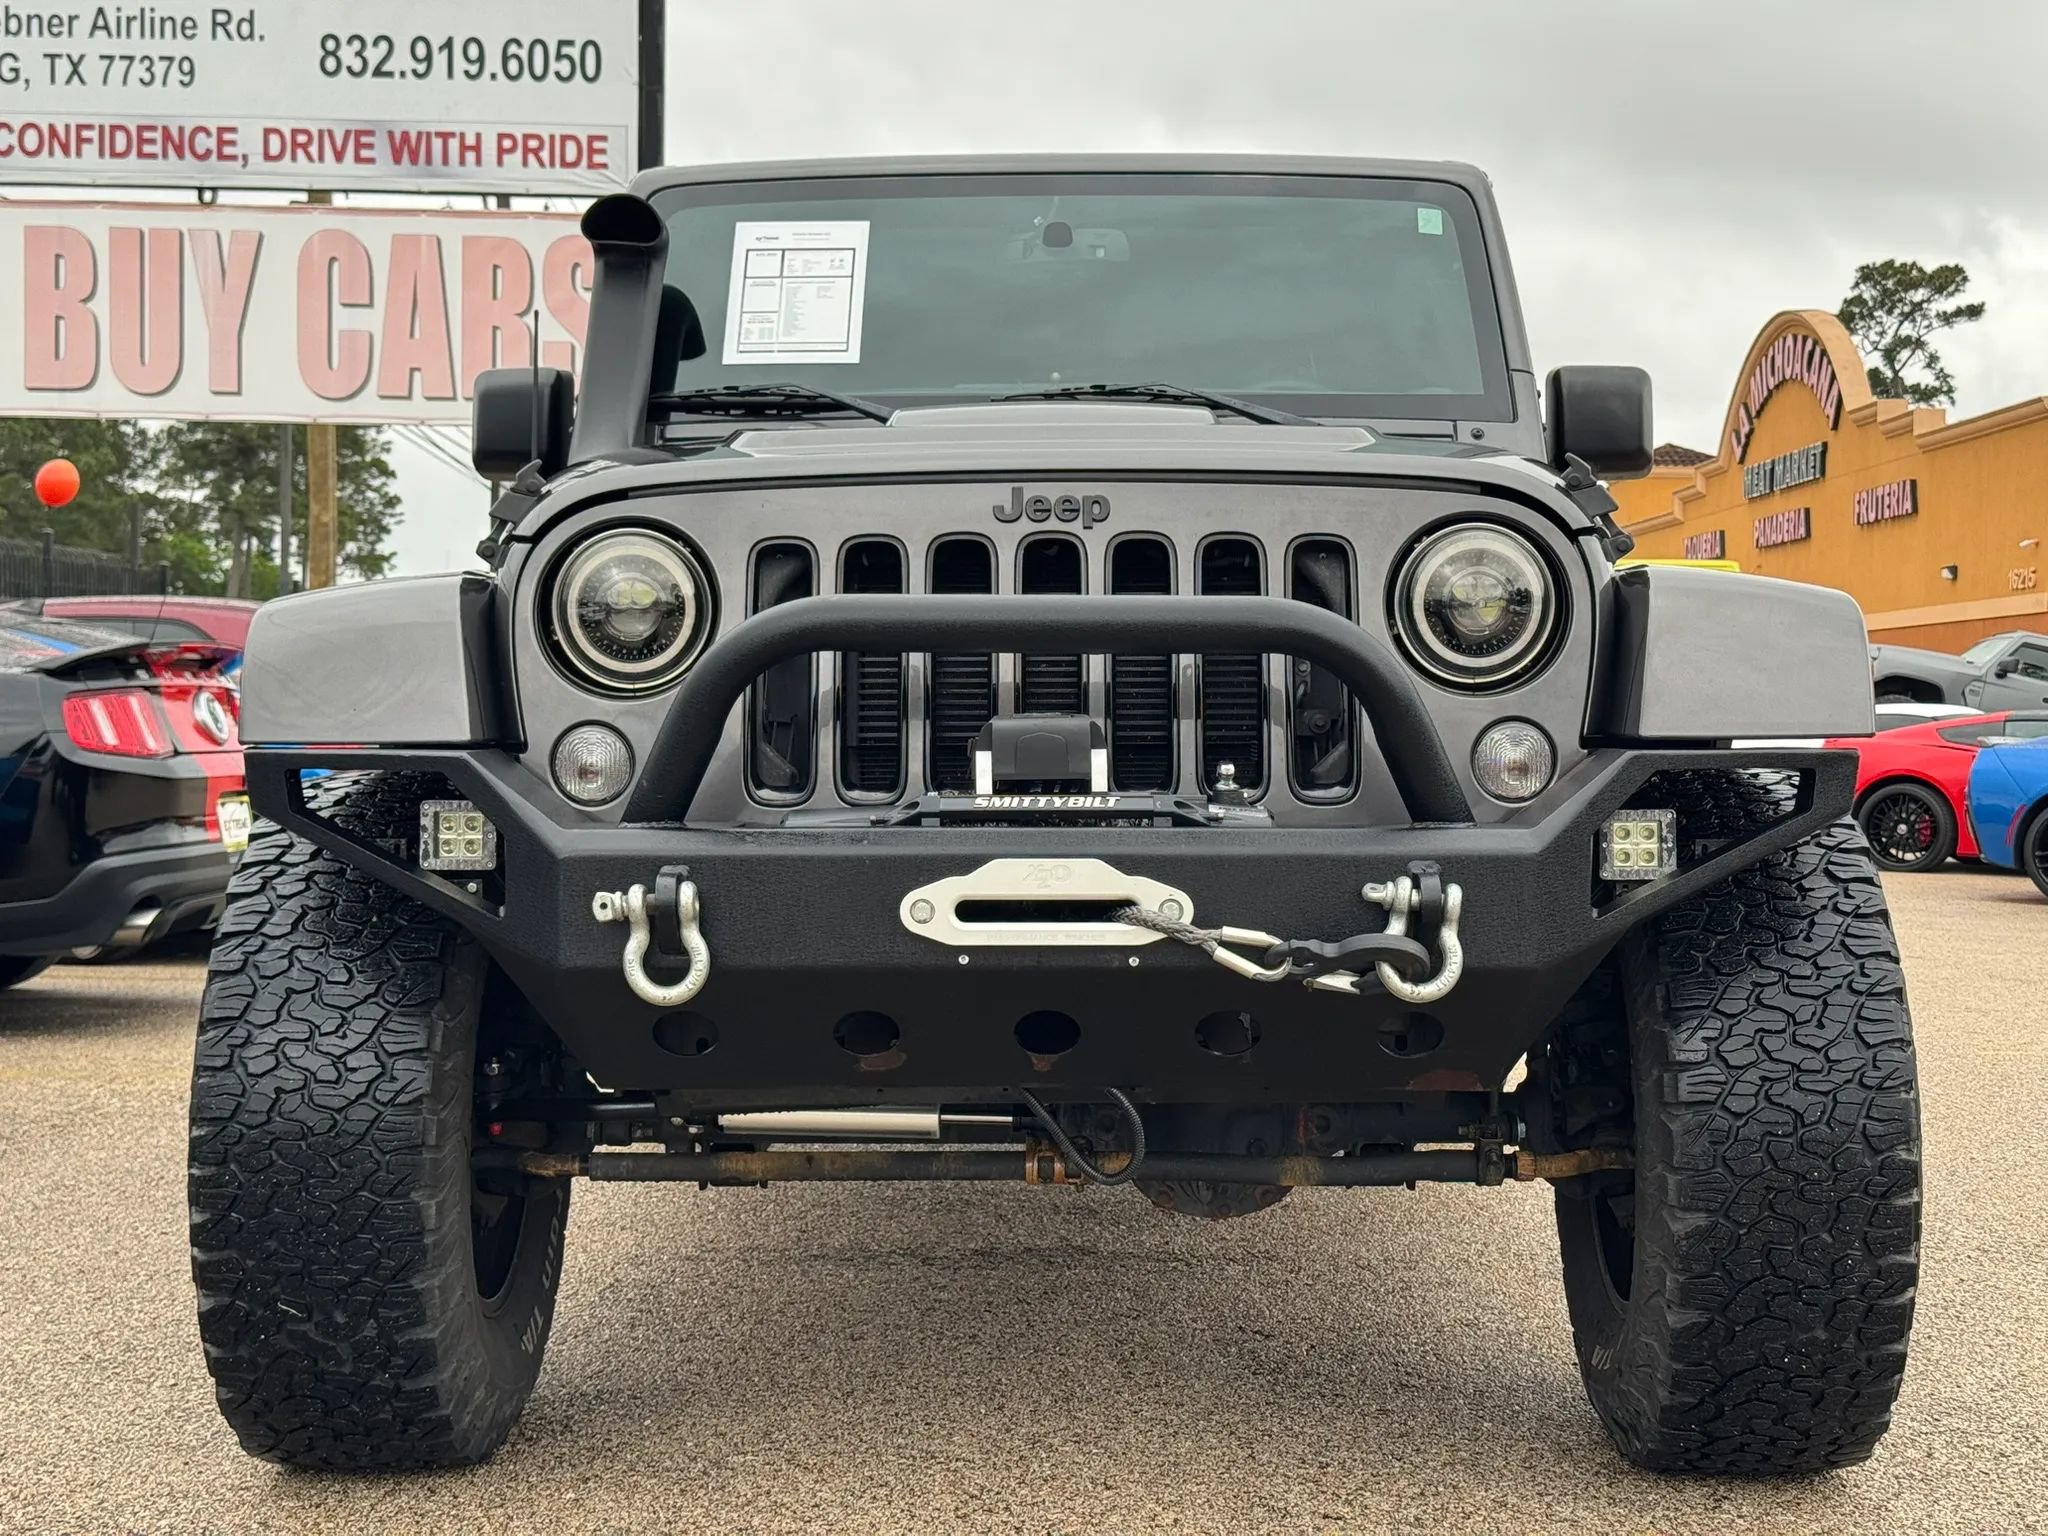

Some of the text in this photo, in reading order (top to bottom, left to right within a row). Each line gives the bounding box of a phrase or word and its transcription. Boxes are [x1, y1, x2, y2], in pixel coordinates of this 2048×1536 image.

[0, 5, 265, 41] bner Airline Rd.
[43, 53, 87, 86] TX
[99, 55, 196, 87] 77379
[318, 34, 602, 83] 832.919.6050
[0, 122, 609, 170] CONFIDENCE, DRIVE WITH PRIDE
[24, 225, 596, 400] BUY CARS
[1731, 333, 1842, 464] LA MICHOACANA
[1773, 441, 1828, 492] MARKET
[992, 486, 1111, 530] Jeep
[1854, 479, 1917, 526] FRUTERIA
[1753, 507, 1811, 549] PANADERIA
[2008, 567, 2036, 591] 16215
[973, 796, 1121, 808] SMITTYBILT
